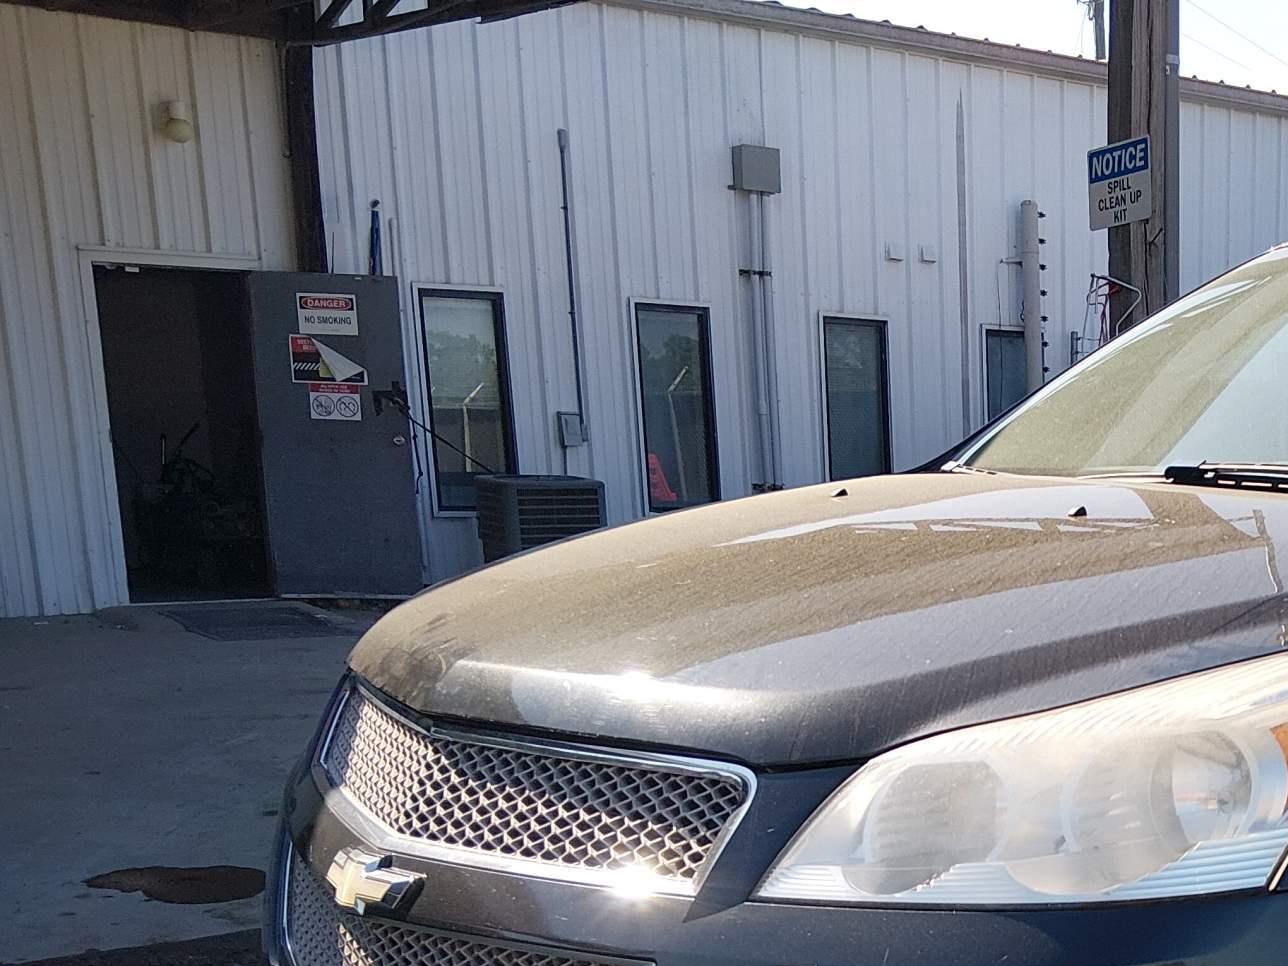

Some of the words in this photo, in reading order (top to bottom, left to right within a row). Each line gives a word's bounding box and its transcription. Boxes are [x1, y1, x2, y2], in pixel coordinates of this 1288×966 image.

[1092, 144, 1146, 178] NOTICE
[1107, 177, 1131, 194] SPILL
[1098, 193, 1127, 212] CLEAN
[1129, 189, 1142, 204] UP
[1113, 208, 1128, 223] KIT
[307, 298, 346, 309] DANGER
[304, 315, 316, 325] NO
[316, 316, 352, 326] SMOKING
